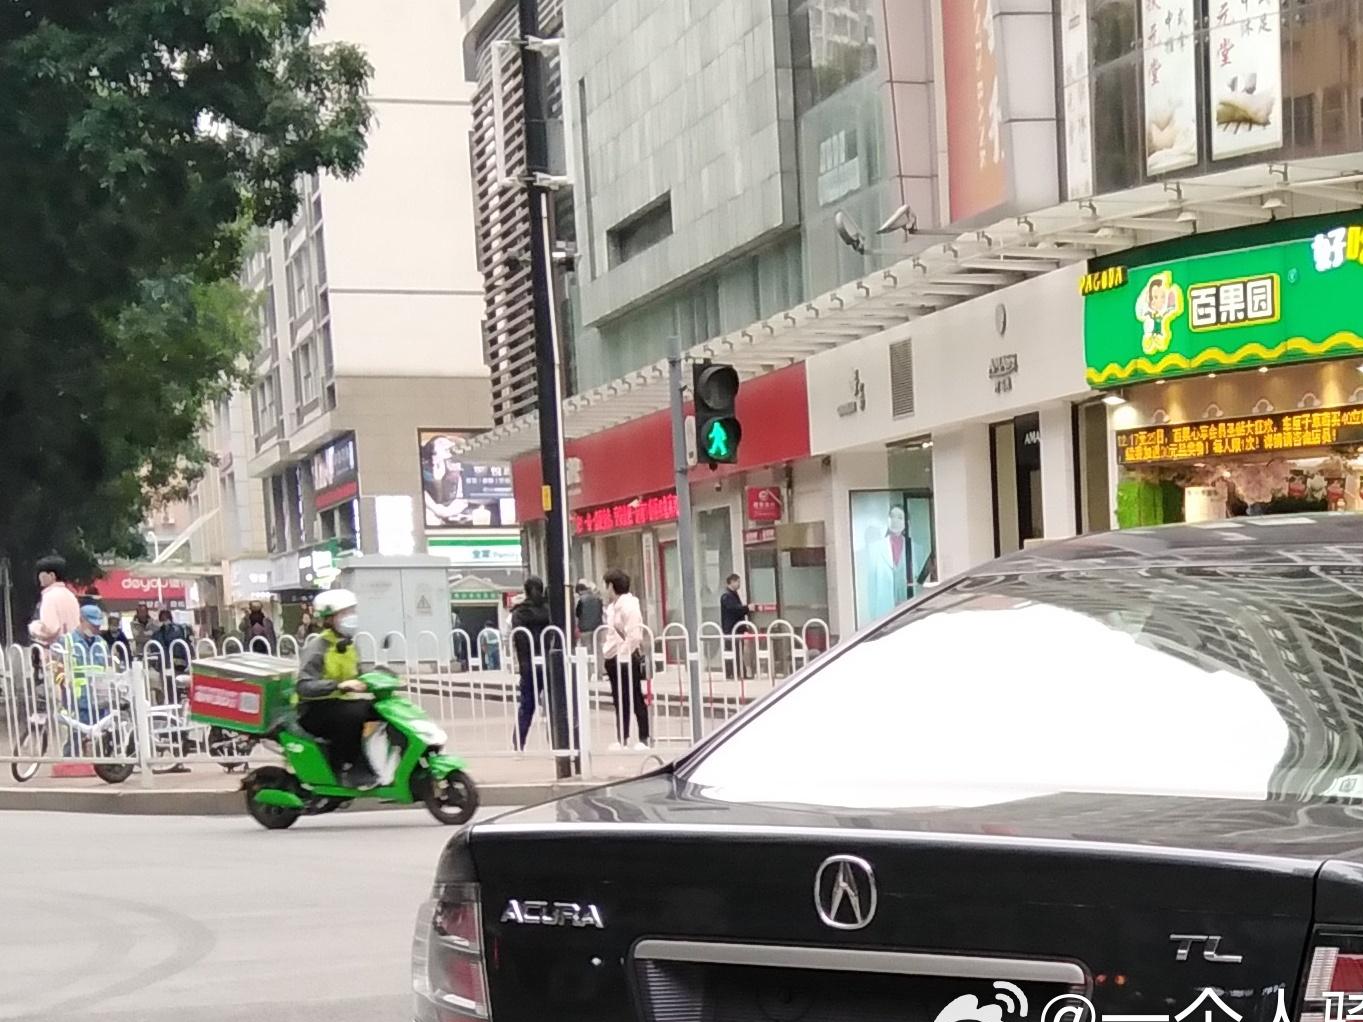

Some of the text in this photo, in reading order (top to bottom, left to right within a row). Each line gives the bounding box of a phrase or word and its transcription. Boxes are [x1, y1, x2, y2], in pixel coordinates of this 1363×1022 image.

[1079, 265, 1126, 296] PAGODA
[1190, 277, 1274, 331] 百果园
[500, 899, 604, 928] ACURA
[1169, 933, 1243, 963] TL
